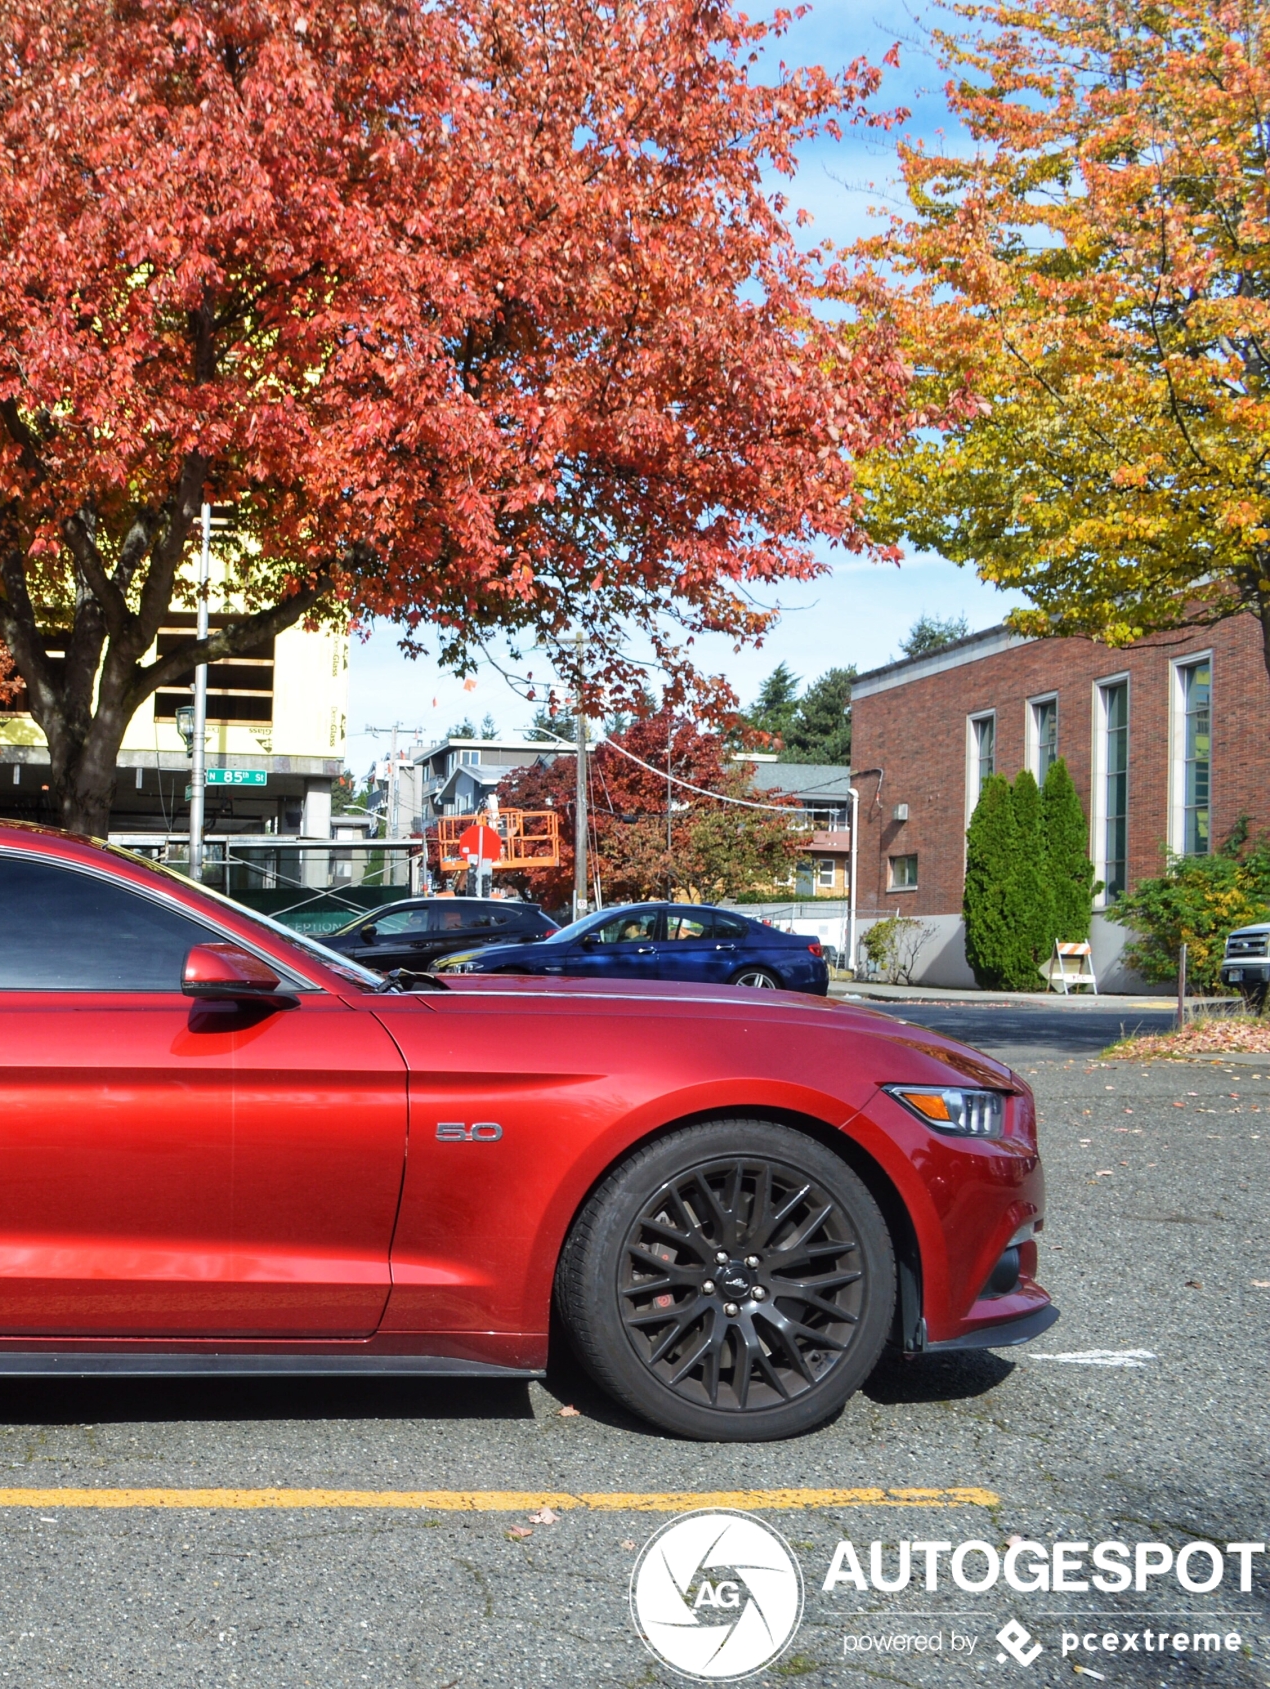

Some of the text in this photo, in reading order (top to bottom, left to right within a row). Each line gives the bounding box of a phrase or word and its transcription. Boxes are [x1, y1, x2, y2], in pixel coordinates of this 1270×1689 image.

[209, 771, 264, 783] N 85th St
[435, 1122, 503, 1142] 5.0
